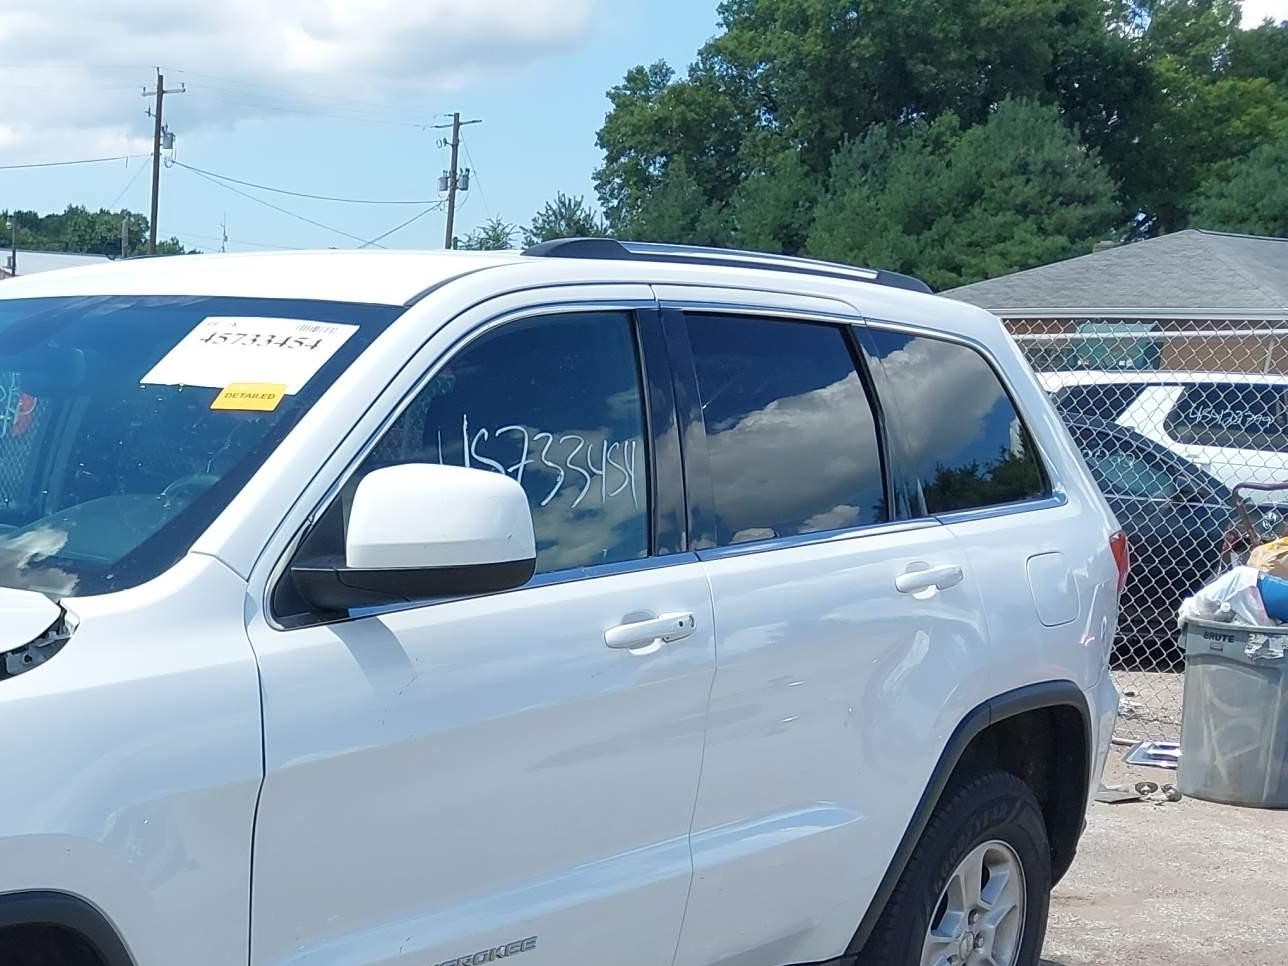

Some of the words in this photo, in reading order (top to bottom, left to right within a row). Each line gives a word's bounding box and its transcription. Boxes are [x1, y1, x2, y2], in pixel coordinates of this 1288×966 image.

[199, 331, 323, 350] 45733454
[224, 391, 276, 401] DETAILED
[1203, 631, 1235, 643] BRUTE
